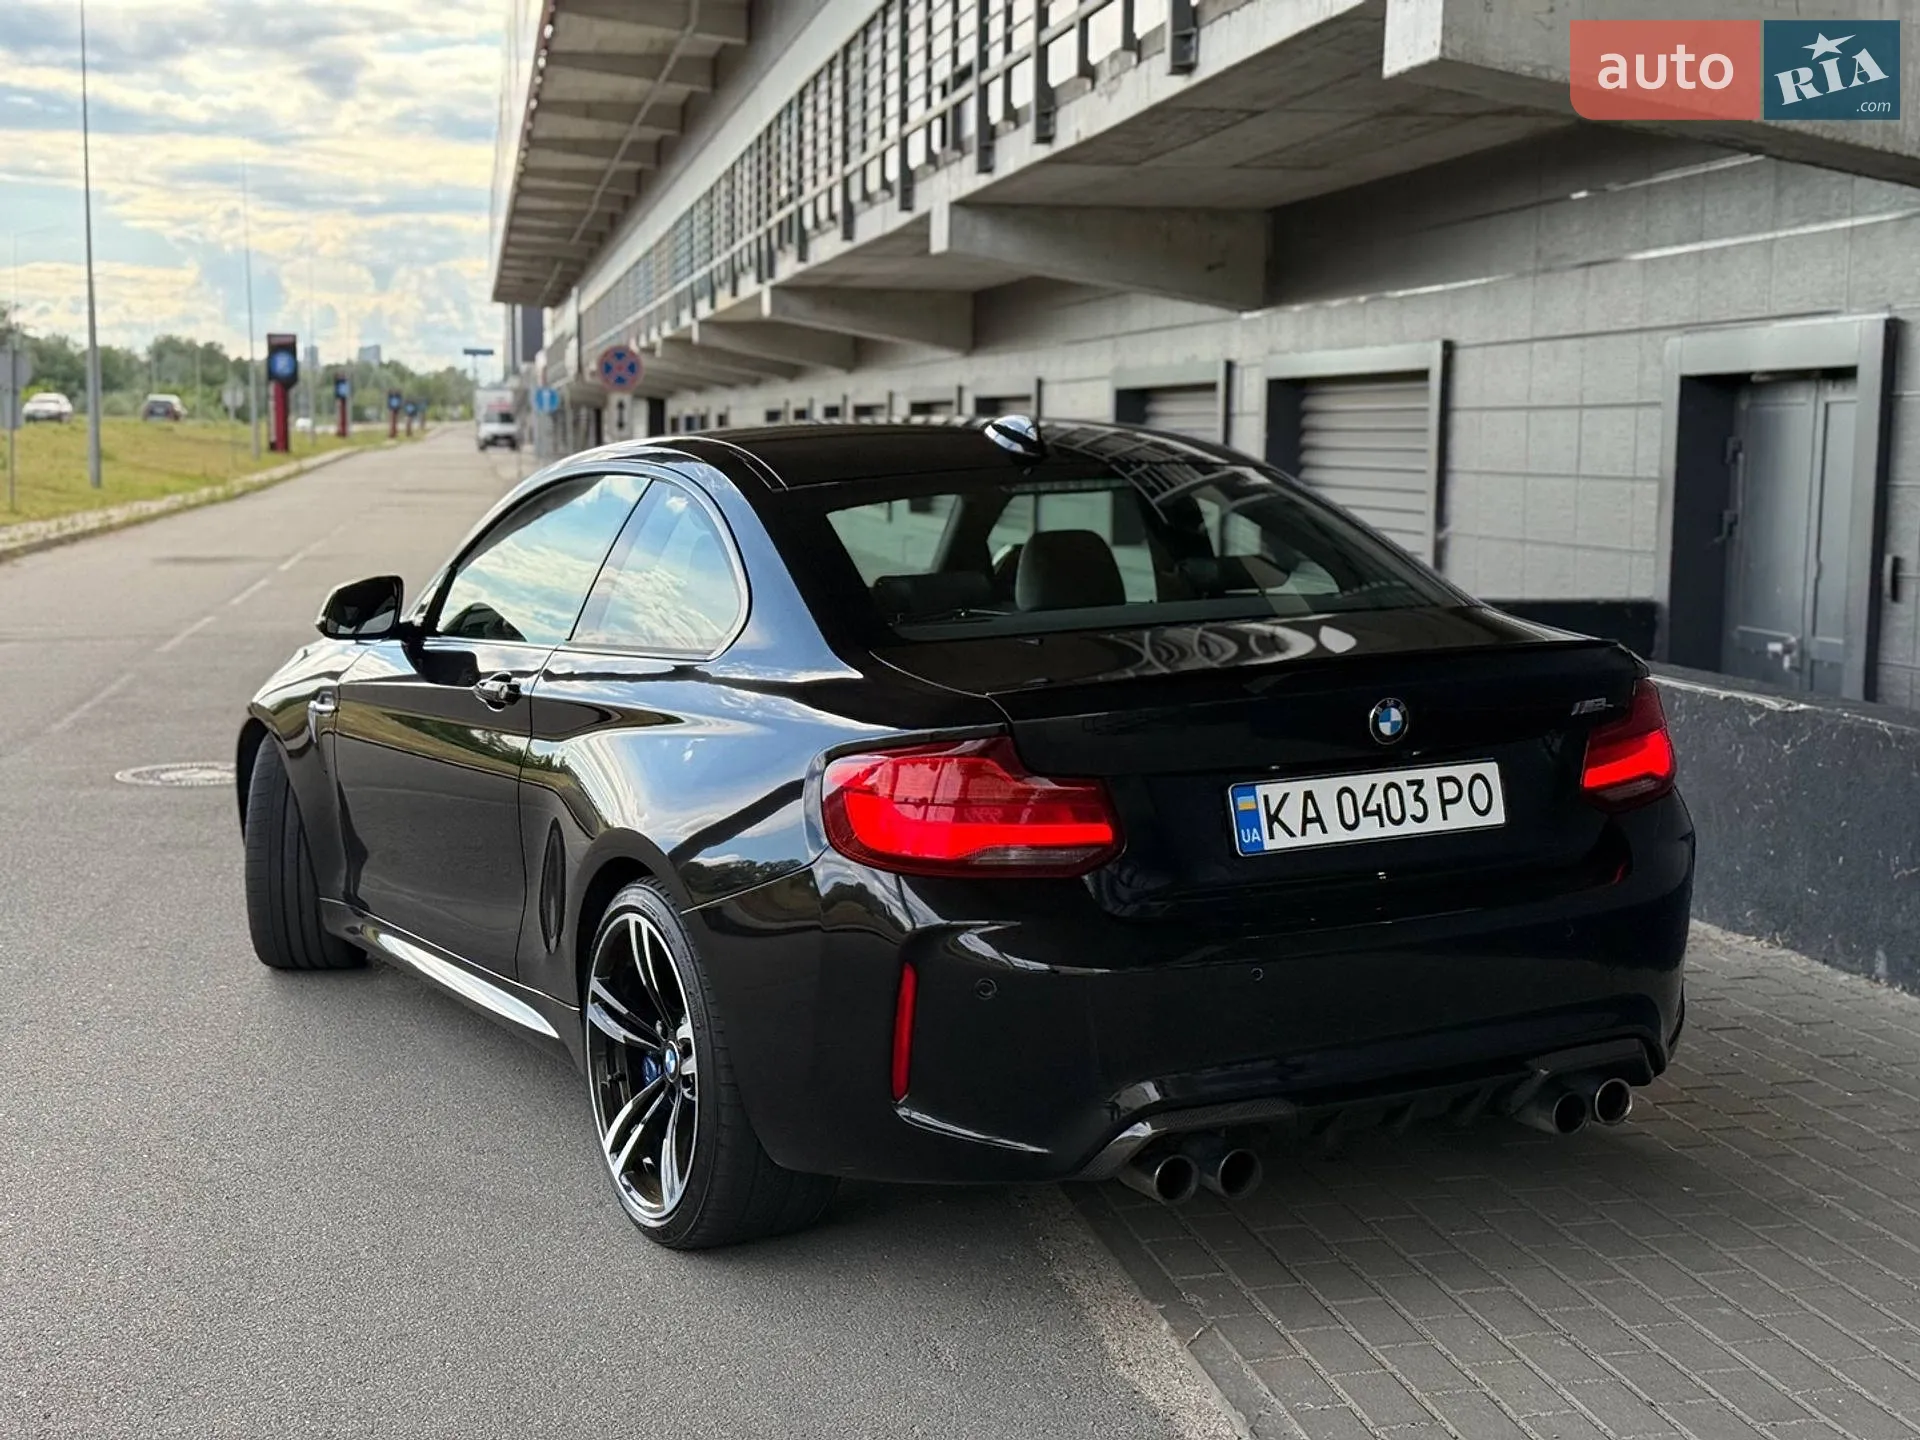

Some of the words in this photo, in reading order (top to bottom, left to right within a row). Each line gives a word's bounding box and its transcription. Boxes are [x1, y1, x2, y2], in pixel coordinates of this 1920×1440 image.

[1262, 790, 1328, 840] KA
[1336, 779, 1429, 831] 0403
[1436, 772, 1494, 821] PO
[1242, 828, 1261, 844] UA
